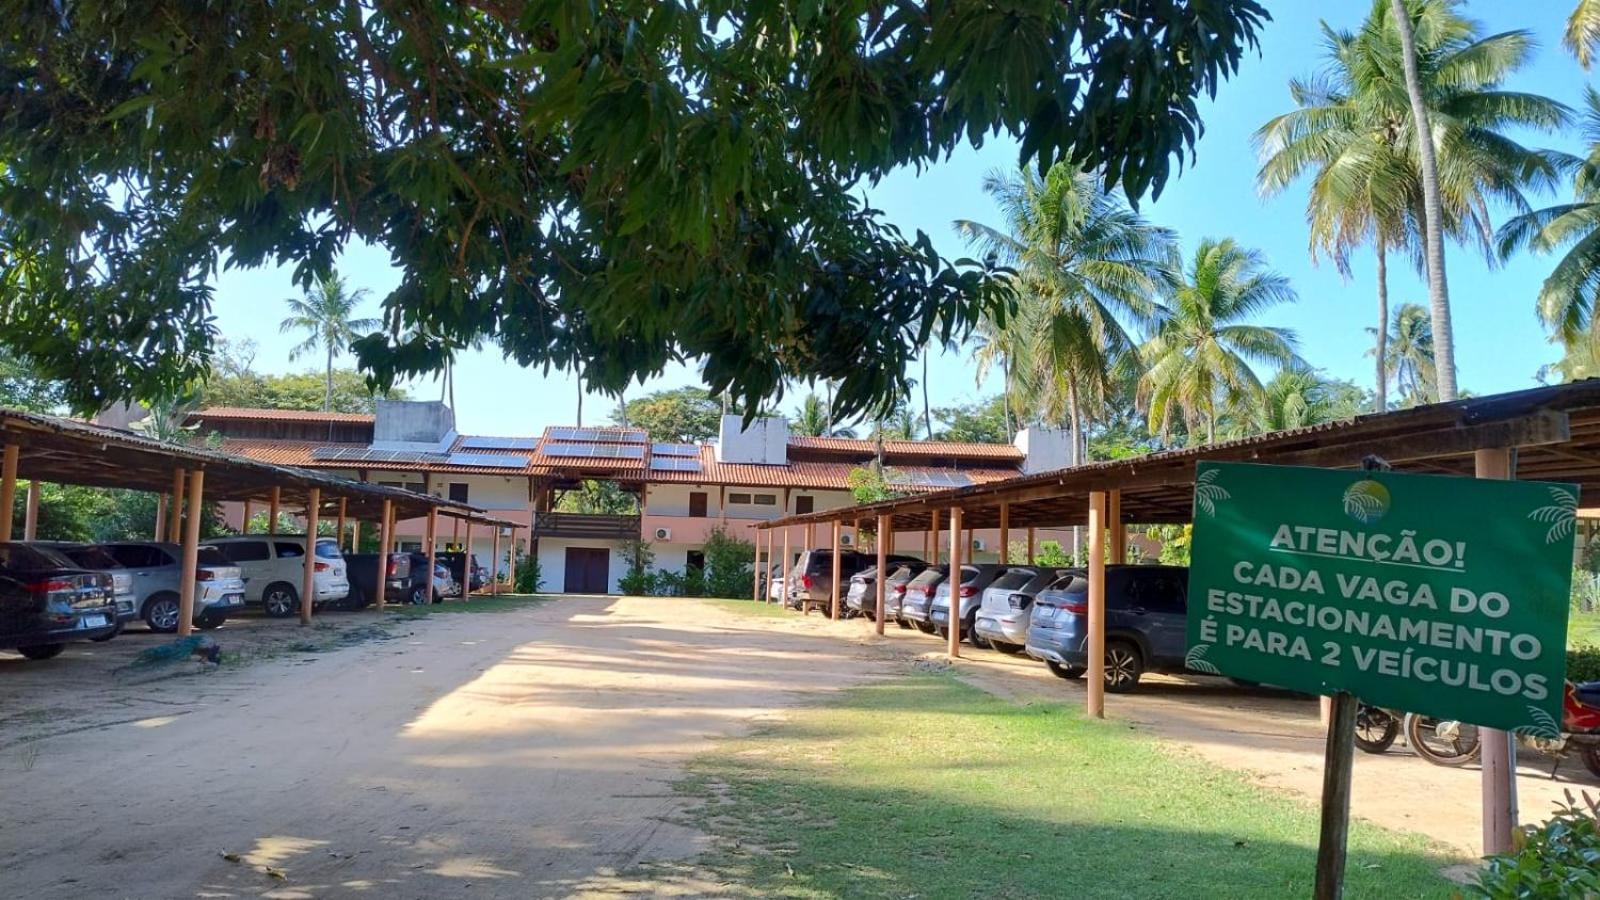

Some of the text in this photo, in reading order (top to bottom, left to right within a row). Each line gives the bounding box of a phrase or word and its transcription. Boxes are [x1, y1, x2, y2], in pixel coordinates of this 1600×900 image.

[1270, 524, 1466, 568] ATENÇÃO!
[1233, 561, 1510, 618] CADA VAGA DO
[1207, 589, 1542, 661] ESTACIONAMENTO
[1200, 615, 1549, 701] É PARA 2 VEÍCULOS
